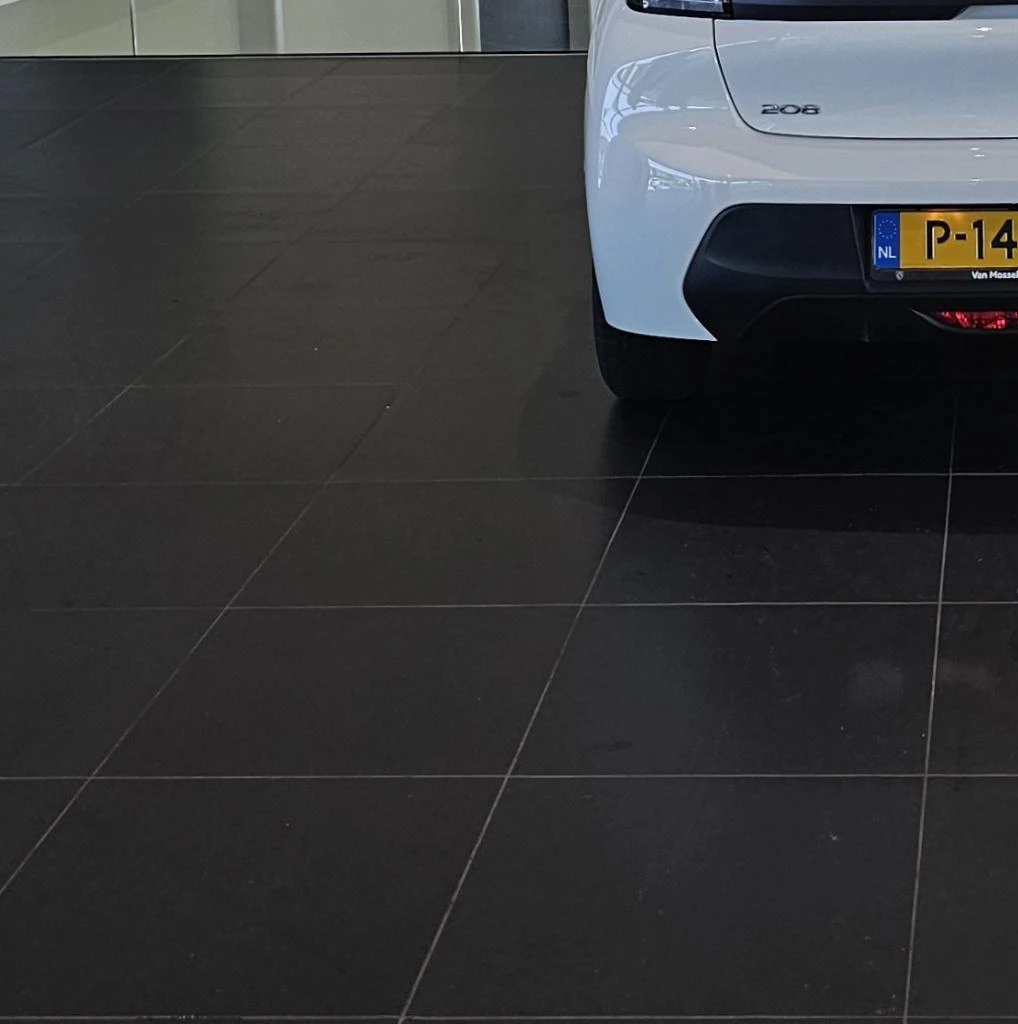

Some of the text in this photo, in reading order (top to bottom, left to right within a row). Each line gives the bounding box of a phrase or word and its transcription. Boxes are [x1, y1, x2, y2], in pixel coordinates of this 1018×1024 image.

[761, 104, 820, 115] 208
[878, 246, 896, 259] NL
[971, 270, 988, 280] Van
[989, 270, 1018, 279] Mossel
